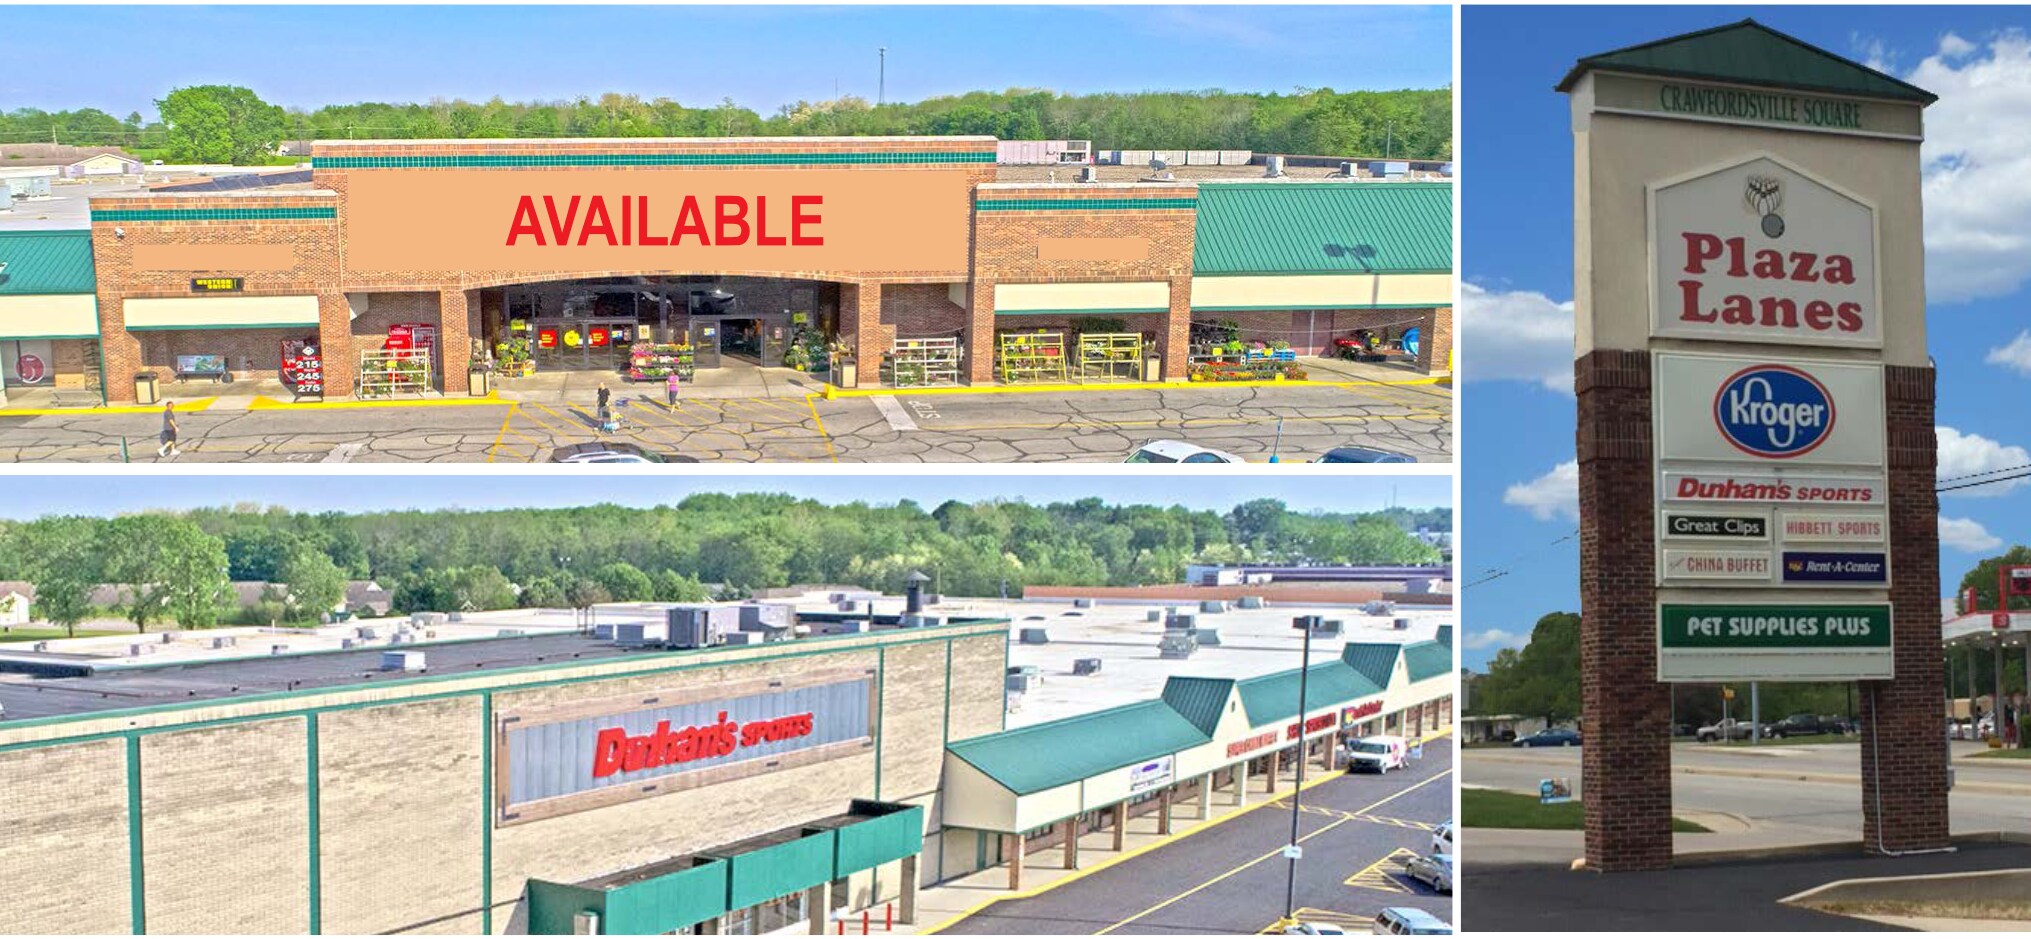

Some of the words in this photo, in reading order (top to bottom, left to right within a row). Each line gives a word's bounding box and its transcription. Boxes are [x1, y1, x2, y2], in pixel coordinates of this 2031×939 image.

[1660, 84, 1798, 123] CRAWFORDSVILLE
[1803, 103, 1863, 128] SQUARE
[1681, 232, 1856, 285] Plaza
[1678, 280, 1863, 332] Lanes
[1731, 377, 1824, 448] Kroger
[1677, 477, 1791, 500] Dunham's
[1796, 487, 1873, 501] SPORTS
[1674, 518, 1718, 532] Great
[1724, 519, 1760, 535] Clips
[1786, 522, 1832, 535] HIBBETT
[1838, 522, 1881, 536] SPORTS
[1687, 557, 1724, 572] CHINA
[1727, 558, 1769, 573] BUFFET
[1687, 616, 1724, 636] PET
[1728, 617, 1819, 636] SUPPLIES
[1825, 617, 1871, 635] PLUS
[593, 711, 738, 778] Dunham's
[740, 712, 814, 748] SPORTS
